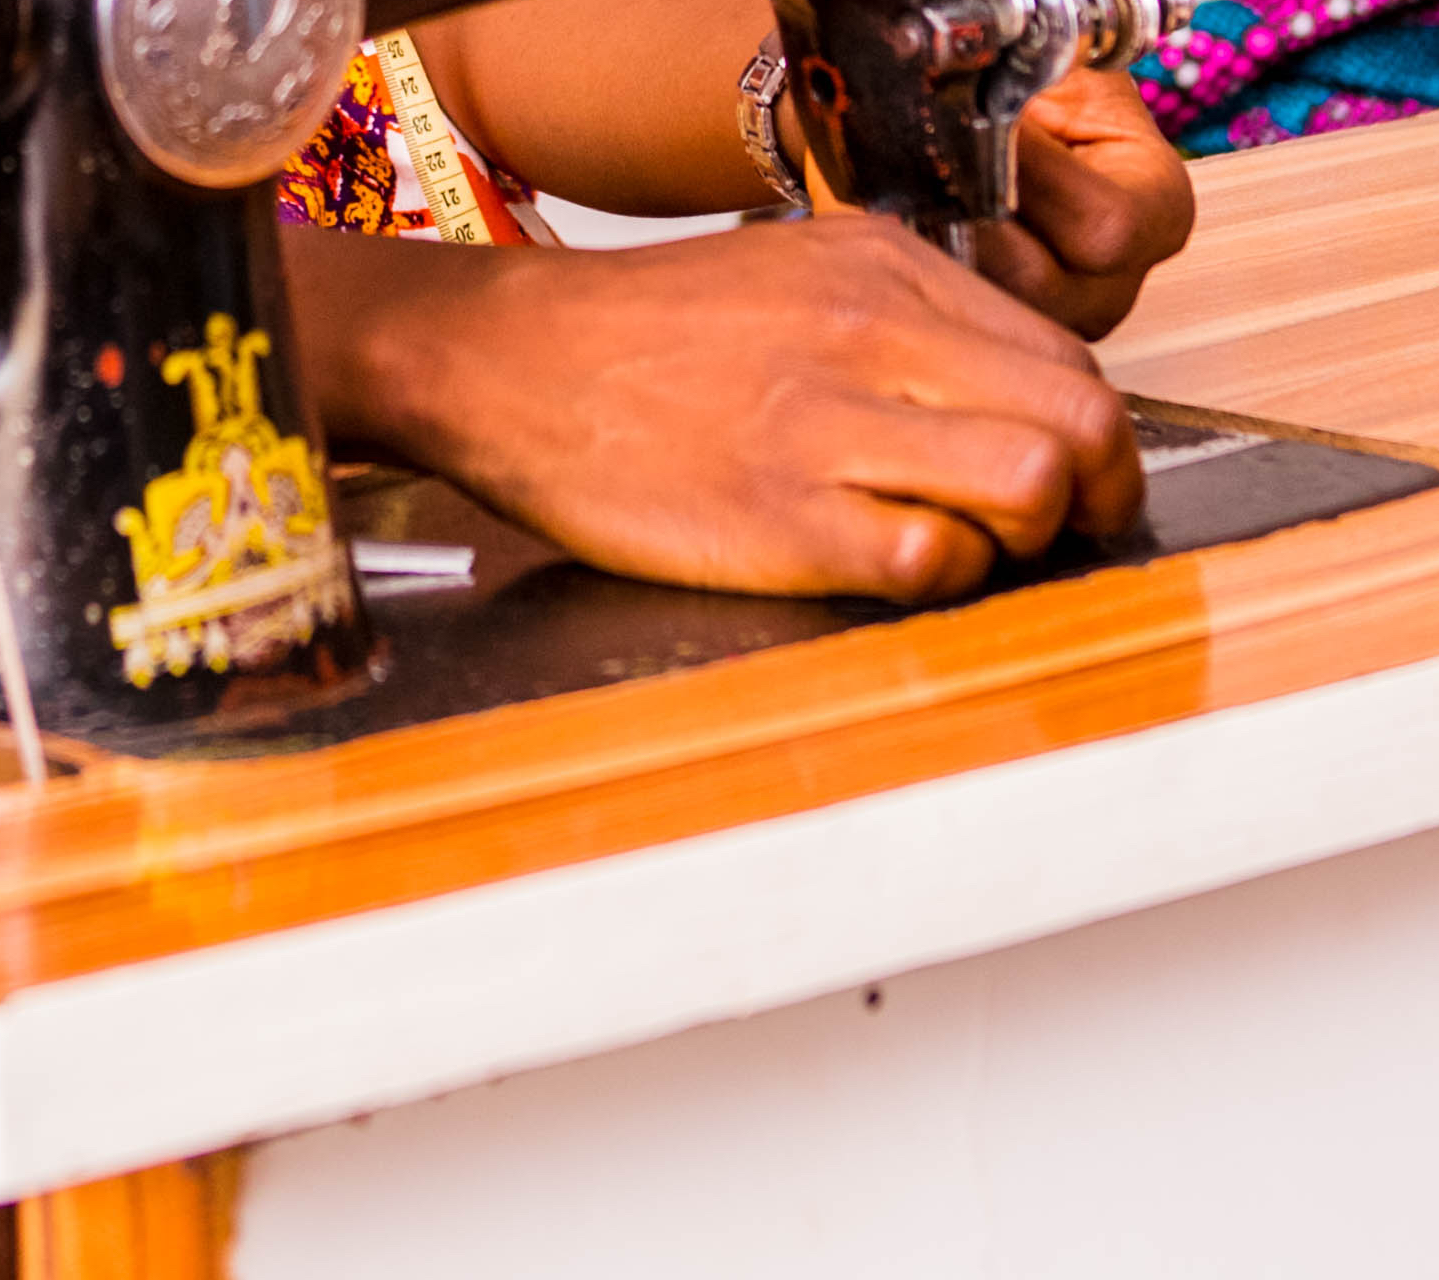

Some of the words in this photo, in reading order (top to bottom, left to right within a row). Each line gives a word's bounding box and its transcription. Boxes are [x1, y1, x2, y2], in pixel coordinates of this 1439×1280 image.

[387, 40, 405, 59] 25
[400, 76, 419, 96] 24
[412, 114, 432, 135] 23
[425, 151, 446, 172] 22
[440, 187, 461, 207] 21
[455, 222, 475, 244] 20
